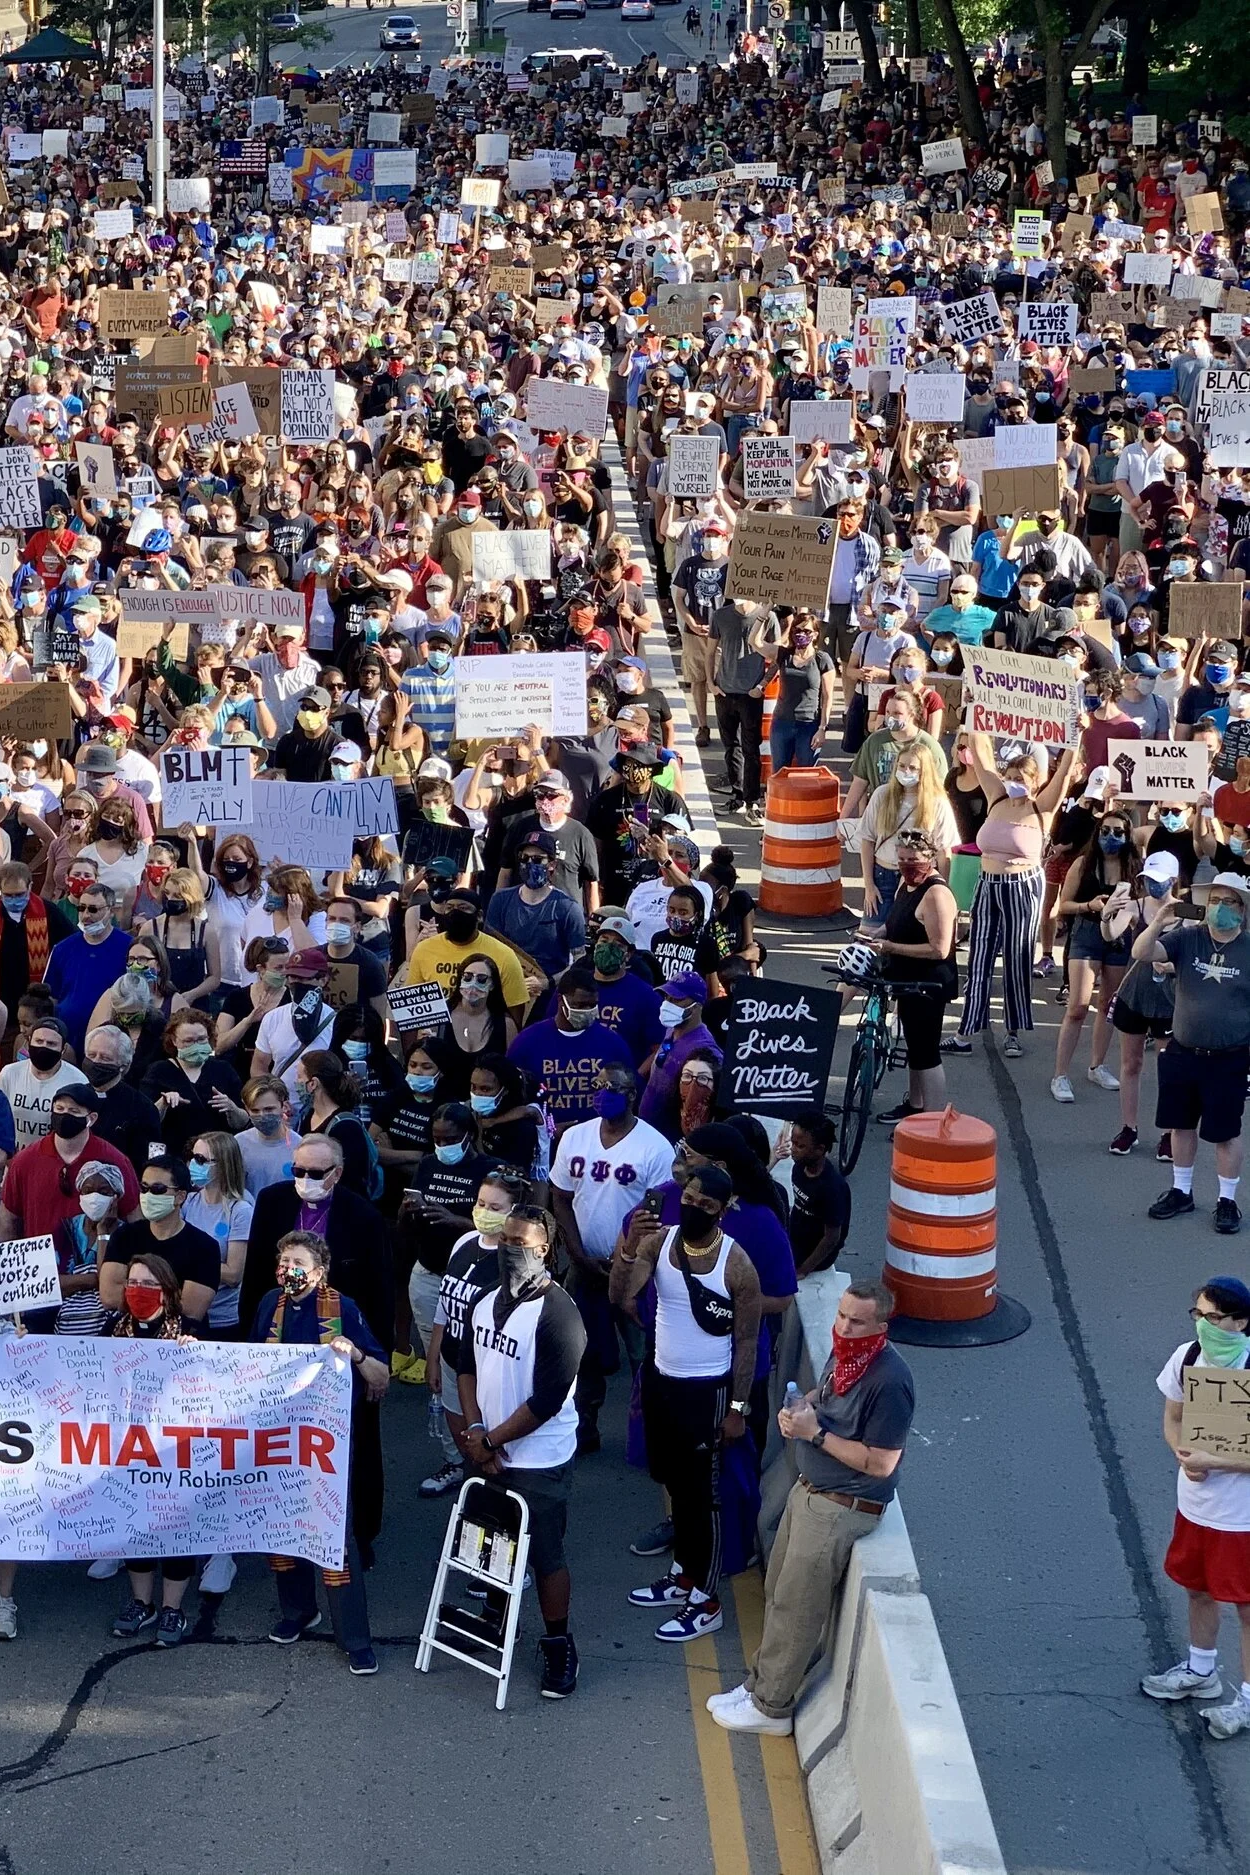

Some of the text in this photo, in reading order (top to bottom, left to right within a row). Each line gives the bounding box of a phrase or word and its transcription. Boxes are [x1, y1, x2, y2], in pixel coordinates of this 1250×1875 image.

[1199, 124, 1220, 138] BLM
[946, 297, 988, 320] BLACK
[1027, 304, 1069, 317] BLACK
[953, 308, 989, 327] LIVES
[1029, 318, 1066, 331] LIVES
[859, 318, 906, 335] BLACK
[950, 315, 1004, 343] MATTER
[1020, 330, 1071, 345] MATTER
[93, 355, 128, 365] WHITE
[855, 347, 906, 368] MATTER
[282, 370, 322, 383] HUMAN
[282, 383, 327, 397] RIGHTS
[158, 386, 212, 416] LISTEN
[282, 396, 333, 410] ARE NOT A
[282, 409, 323, 424] MATTER
[192, 427, 231, 446] PEACE
[283, 422, 330, 438] OPINION
[6, 448, 29, 456] LIVES
[675, 440, 714, 450] DESTROY
[746, 441, 781, 450] WE WILL
[6, 455, 32, 464] DON'T
[675, 451, 710, 460] THE WHITE
[747, 449, 789, 459] KEEP UP THE
[678, 474, 707, 482] WITHIN
[747, 470, 782, 479] WE WILL
[748, 479, 791, 489] NOT MOVE ON
[768, 523, 818, 540] LIVES MATTER
[121, 595, 301, 617] ENOUGH IS ENOUGH NOW
[55, 634, 72, 643] SAY
[53, 642, 78, 651] THEIR
[52, 651, 80, 662] NAMES
[459, 659, 481, 672] RIP
[1145, 746, 1188, 759] BLACK
[164, 751, 222, 783] BLM
[1145, 762, 1187, 775] LIVES
[1146, 776, 1196, 789] MATTER
[197, 800, 244, 822] ALLY
[678, 946, 696, 961] GIRL
[387, 983, 439, 1001] HISTORY HAS
[392, 992, 440, 1008] ITS EYES ON
[407, 1003, 433, 1017] YOU
[735, 996, 818, 1024] Black
[735, 1029, 818, 1060] Lives
[542, 1059, 602, 1074] BLACK
[731, 1064, 819, 1095] Matter
[0, 1252, 26, 1269] evil
[248, 1347, 317, 1364] George Floyd
[60, 1421, 337, 1475] MATTER
[127, 1469, 268, 1489] Tony Robinson
